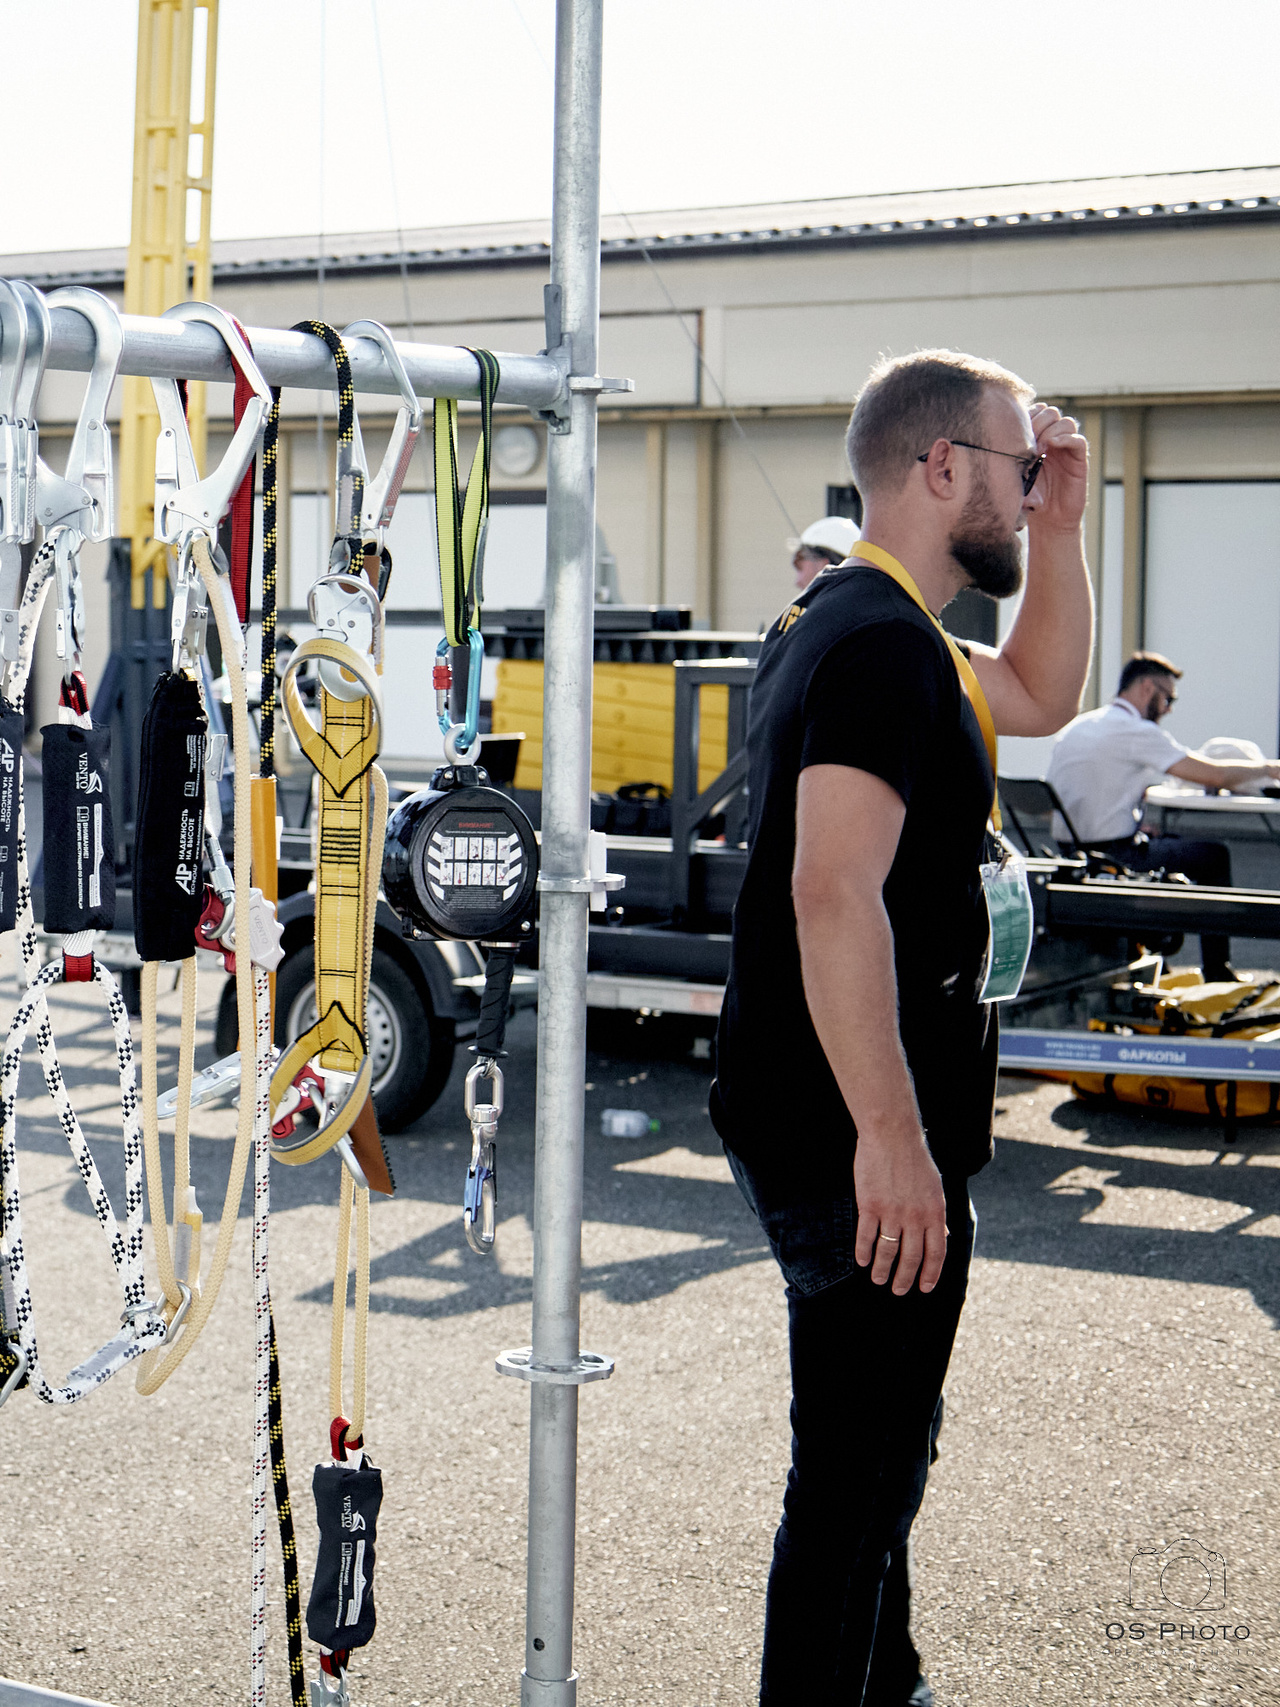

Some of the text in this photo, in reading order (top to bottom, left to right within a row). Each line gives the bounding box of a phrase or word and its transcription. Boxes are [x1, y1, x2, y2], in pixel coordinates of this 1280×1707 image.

[2, 777, 8, 788] НА
[78, 752, 88, 788] VENTO
[5, 777, 13, 832] НАДЕЖНОСТЬ
[179, 809, 189, 860] НАДЕЖНОСТЬ
[186, 818, 195, 860] НА ВЫСОТЕ
[255, 915, 269, 944] VENTO
[1118, 1048, 1186, 1064] ФАРКОПЫ
[343, 1495, 352, 1528] VENTO
